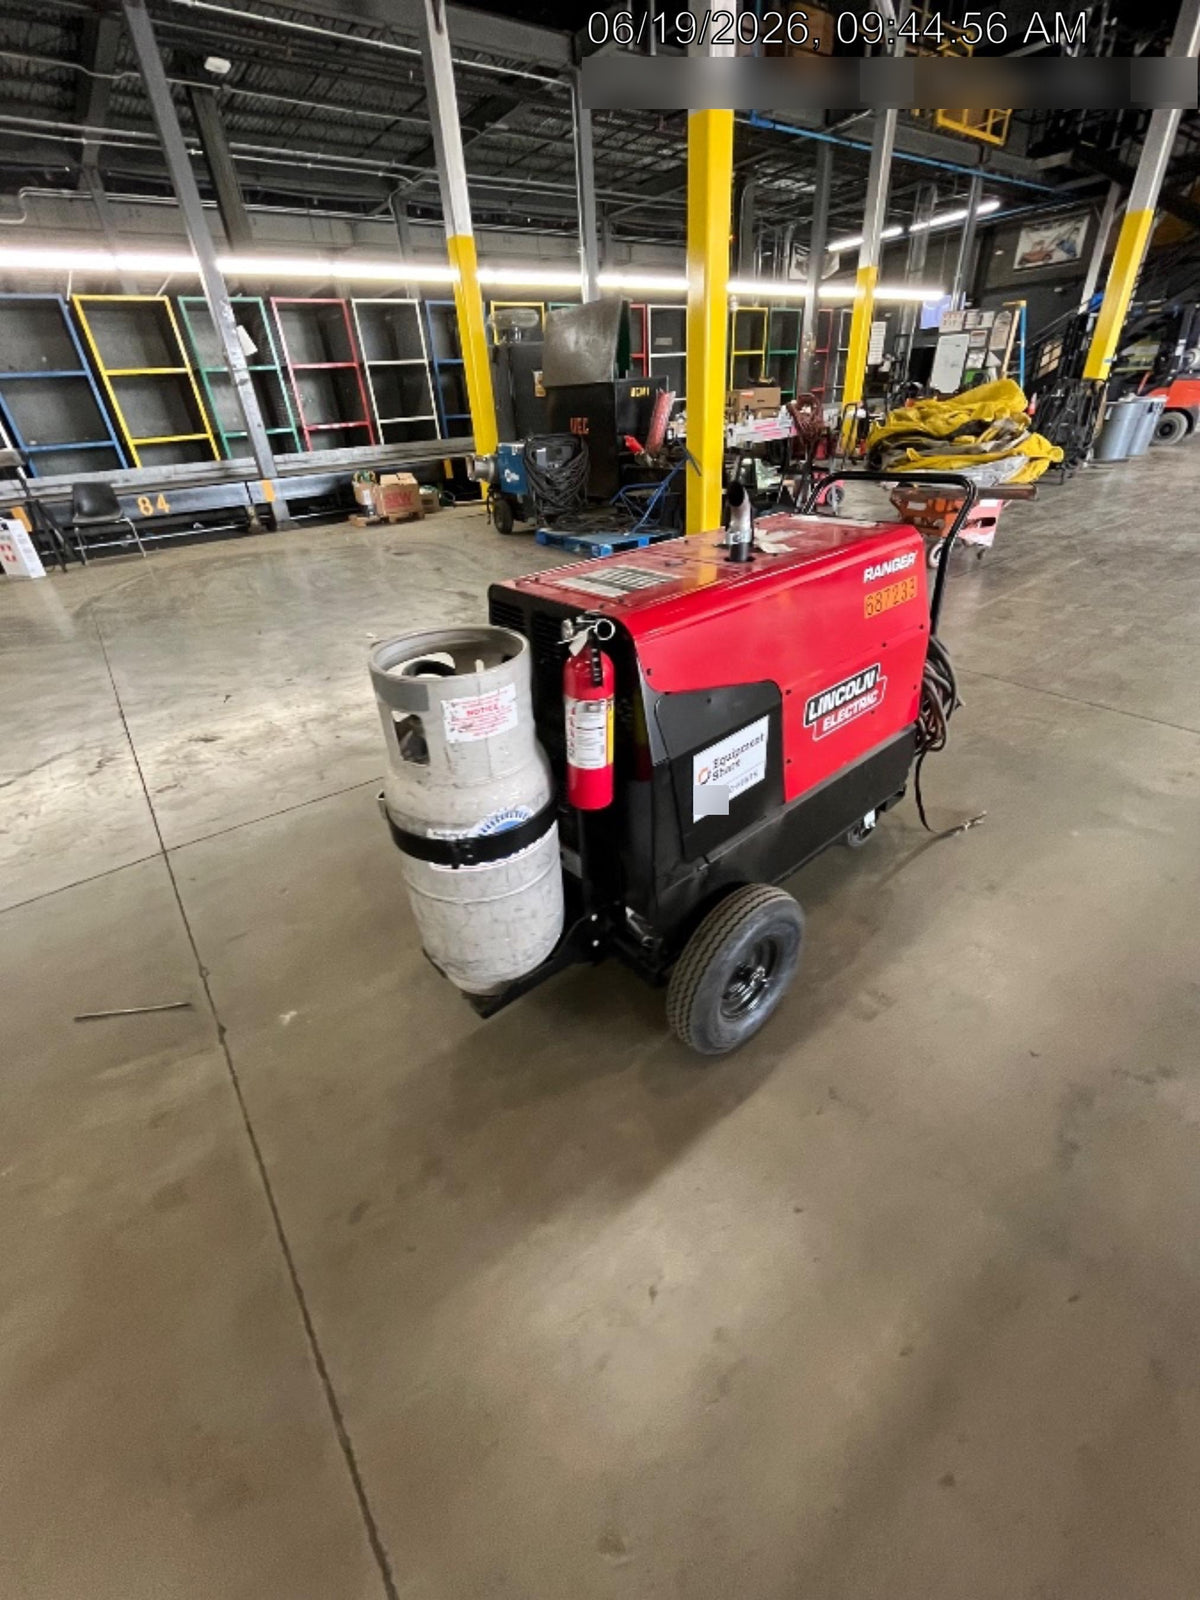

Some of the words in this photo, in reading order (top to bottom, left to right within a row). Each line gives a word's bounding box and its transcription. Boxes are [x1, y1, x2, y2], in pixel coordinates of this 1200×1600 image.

[137, 493, 170, 516] 84
[863, 550, 918, 583] RANGER
[808, 668, 877, 722] LINCOLN
[822, 688, 879, 732] ELECTRIC
[713, 732, 764, 770] Equipment
[712, 758, 741, 782] Share
